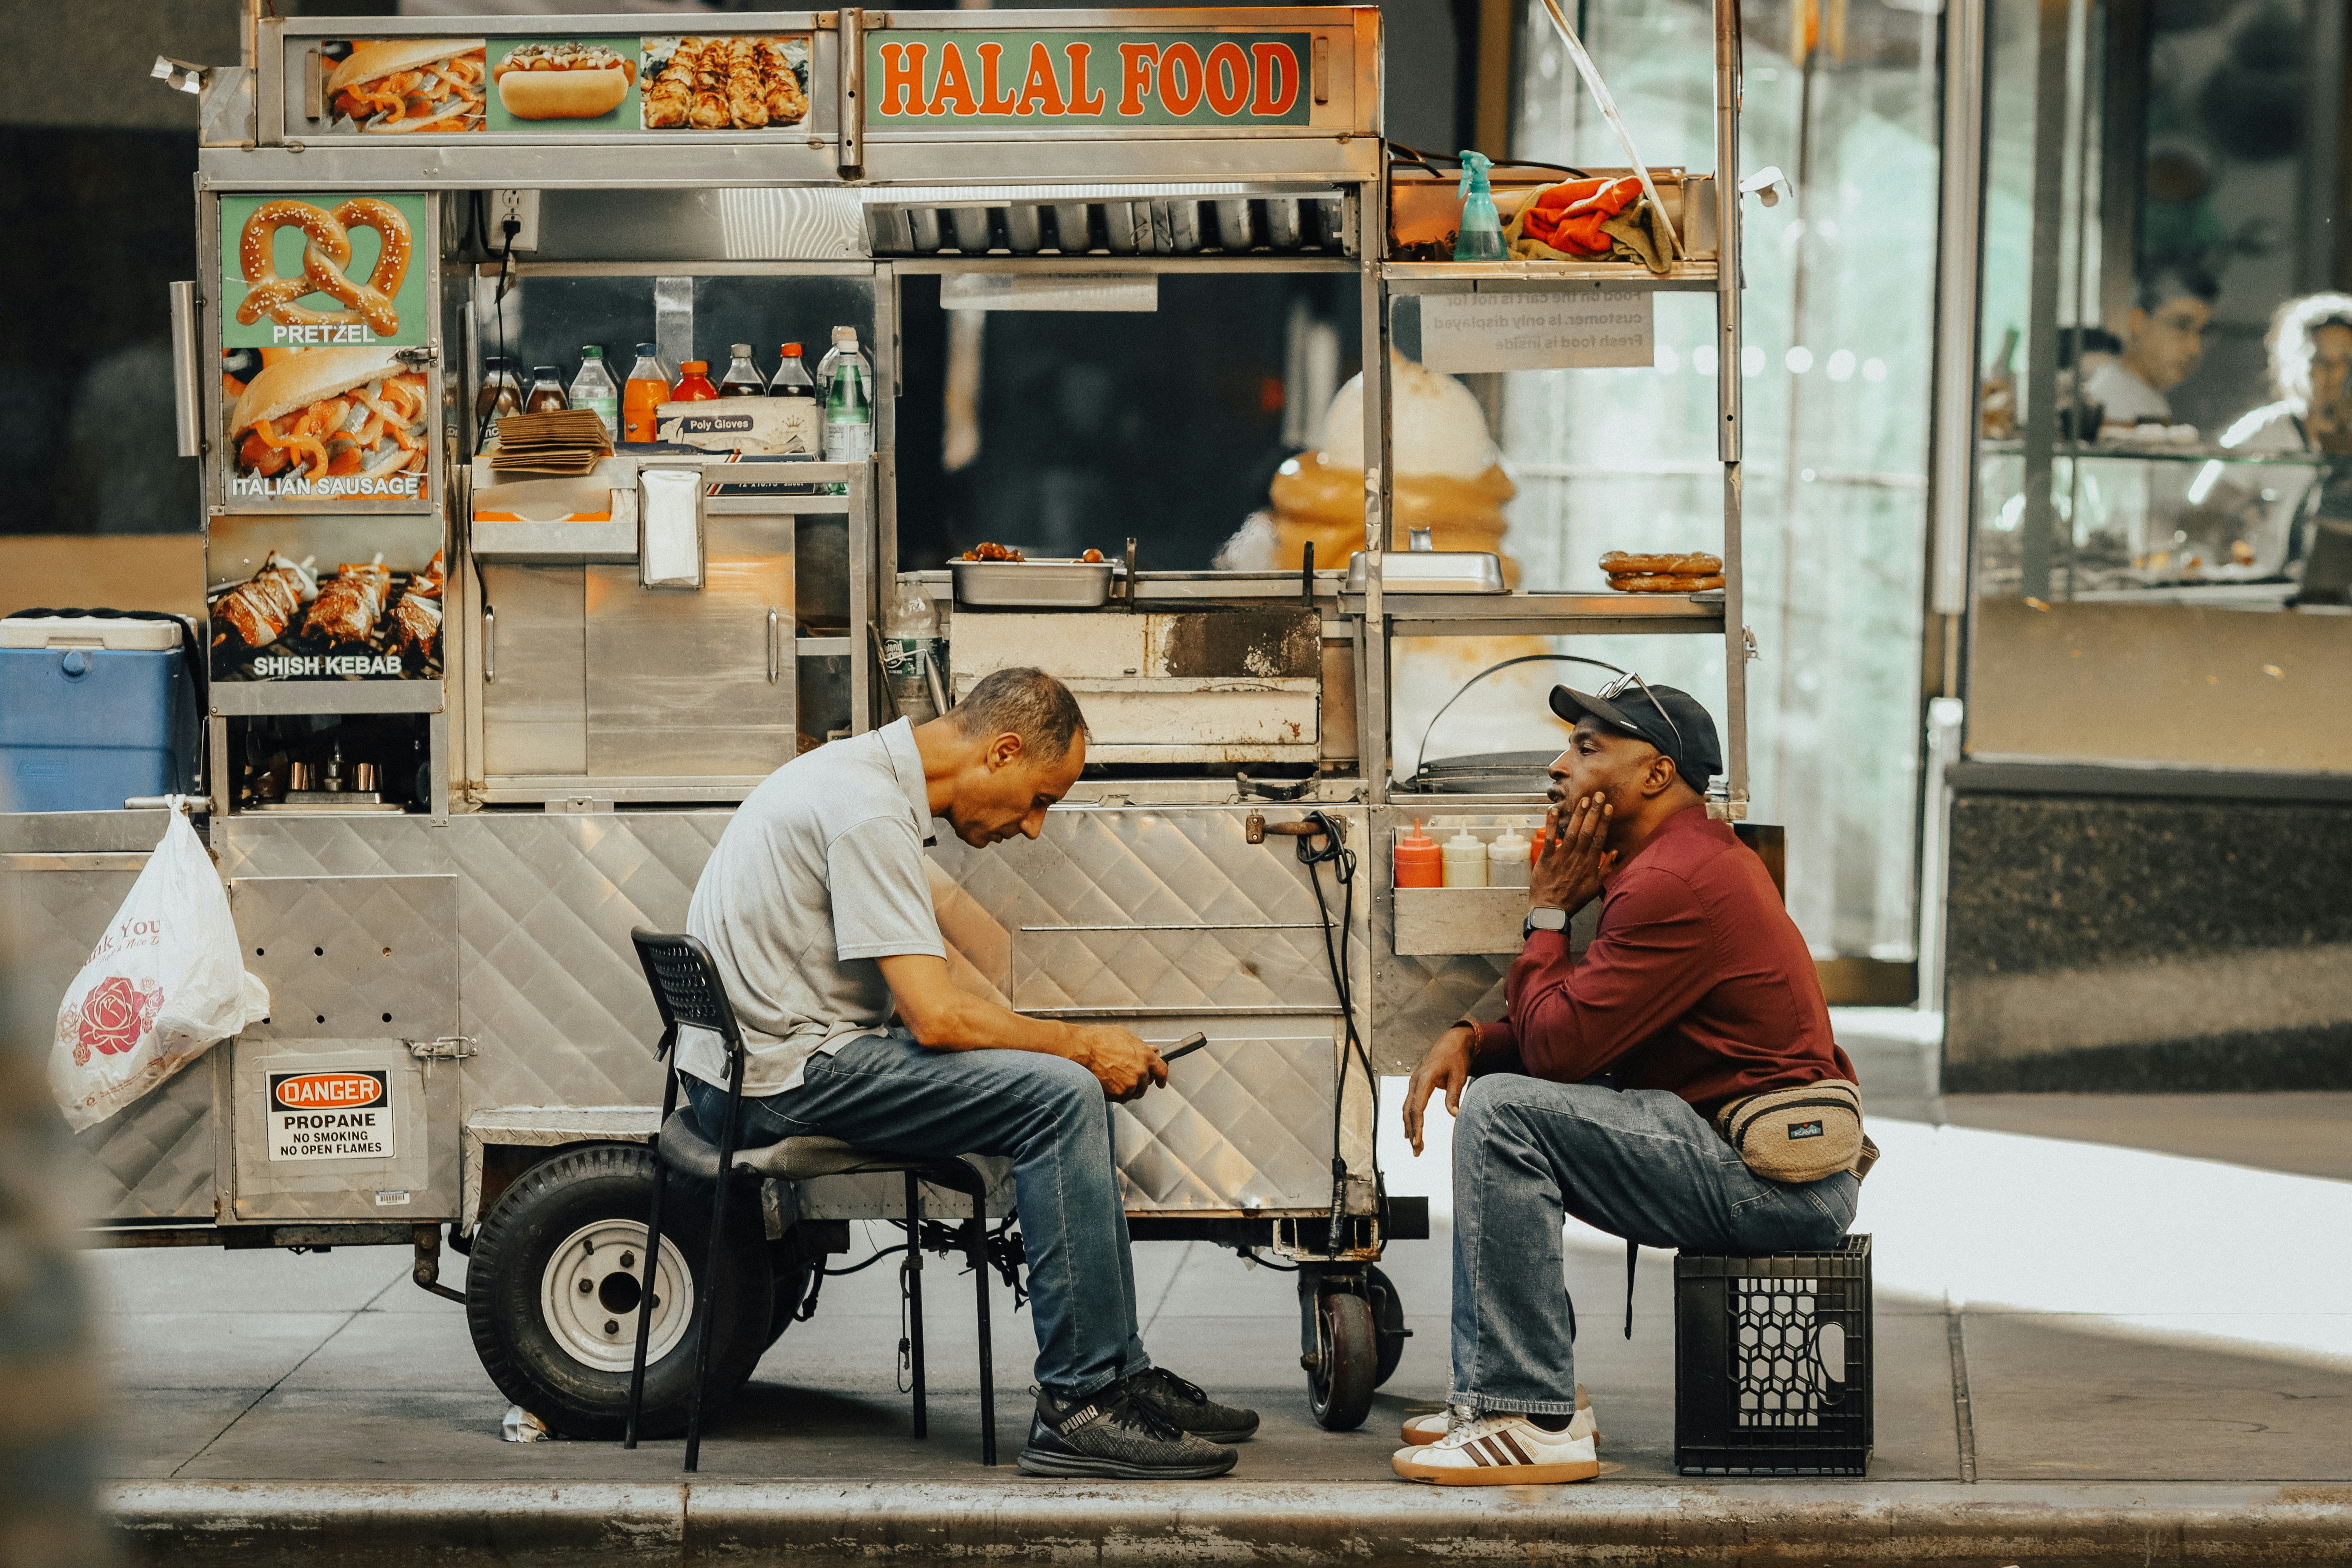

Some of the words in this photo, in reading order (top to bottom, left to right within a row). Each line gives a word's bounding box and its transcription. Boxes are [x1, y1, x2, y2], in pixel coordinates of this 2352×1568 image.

[879, 41, 1105, 117] HALAL
[1117, 41, 1300, 117] FOOD
[273, 325, 376, 343] PRETZEL
[690, 419, 712, 431] Poly
[714, 419, 749, 429] Gloves
[232, 478, 311, 495] ITALIAN
[317, 476, 418, 495] SAUSAGE
[253, 655, 319, 676] SHISH
[325, 655, 401, 675] KEBAB
[284, 1079, 375, 1102] DANGER
[284, 1113, 376, 1129] PROPANE
[293, 1133, 310, 1143] NO
[313, 1131, 368, 1142] SMOKING
[1794, 1128, 1817, 1137] KAVU
[280, 1146, 297, 1156] NO
[301, 1144, 332, 1155] OPEN
[336, 1143, 382, 1154] FLAMES
[1059, 1405, 1099, 1435] PUMA
